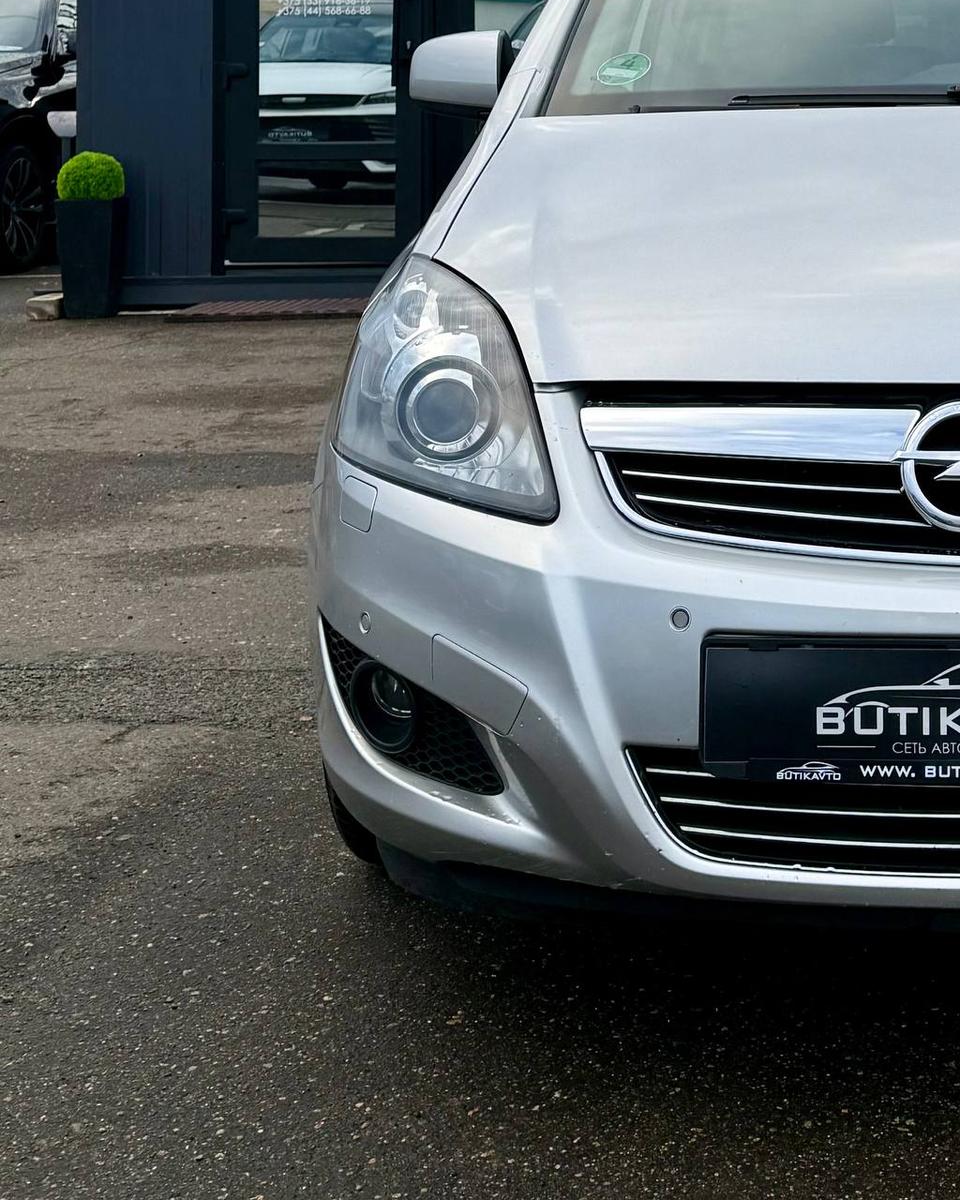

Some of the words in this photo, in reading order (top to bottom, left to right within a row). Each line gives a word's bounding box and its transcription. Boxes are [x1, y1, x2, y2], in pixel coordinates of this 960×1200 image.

[303, 6, 322, 17] (44)
[324, 6, 371, 15] 568-66-88
[892, 742, 927, 754] СЕТЬ
[776, 770, 842, 781] BUTIKAVTO
[859, 764, 916, 778] WWW.
